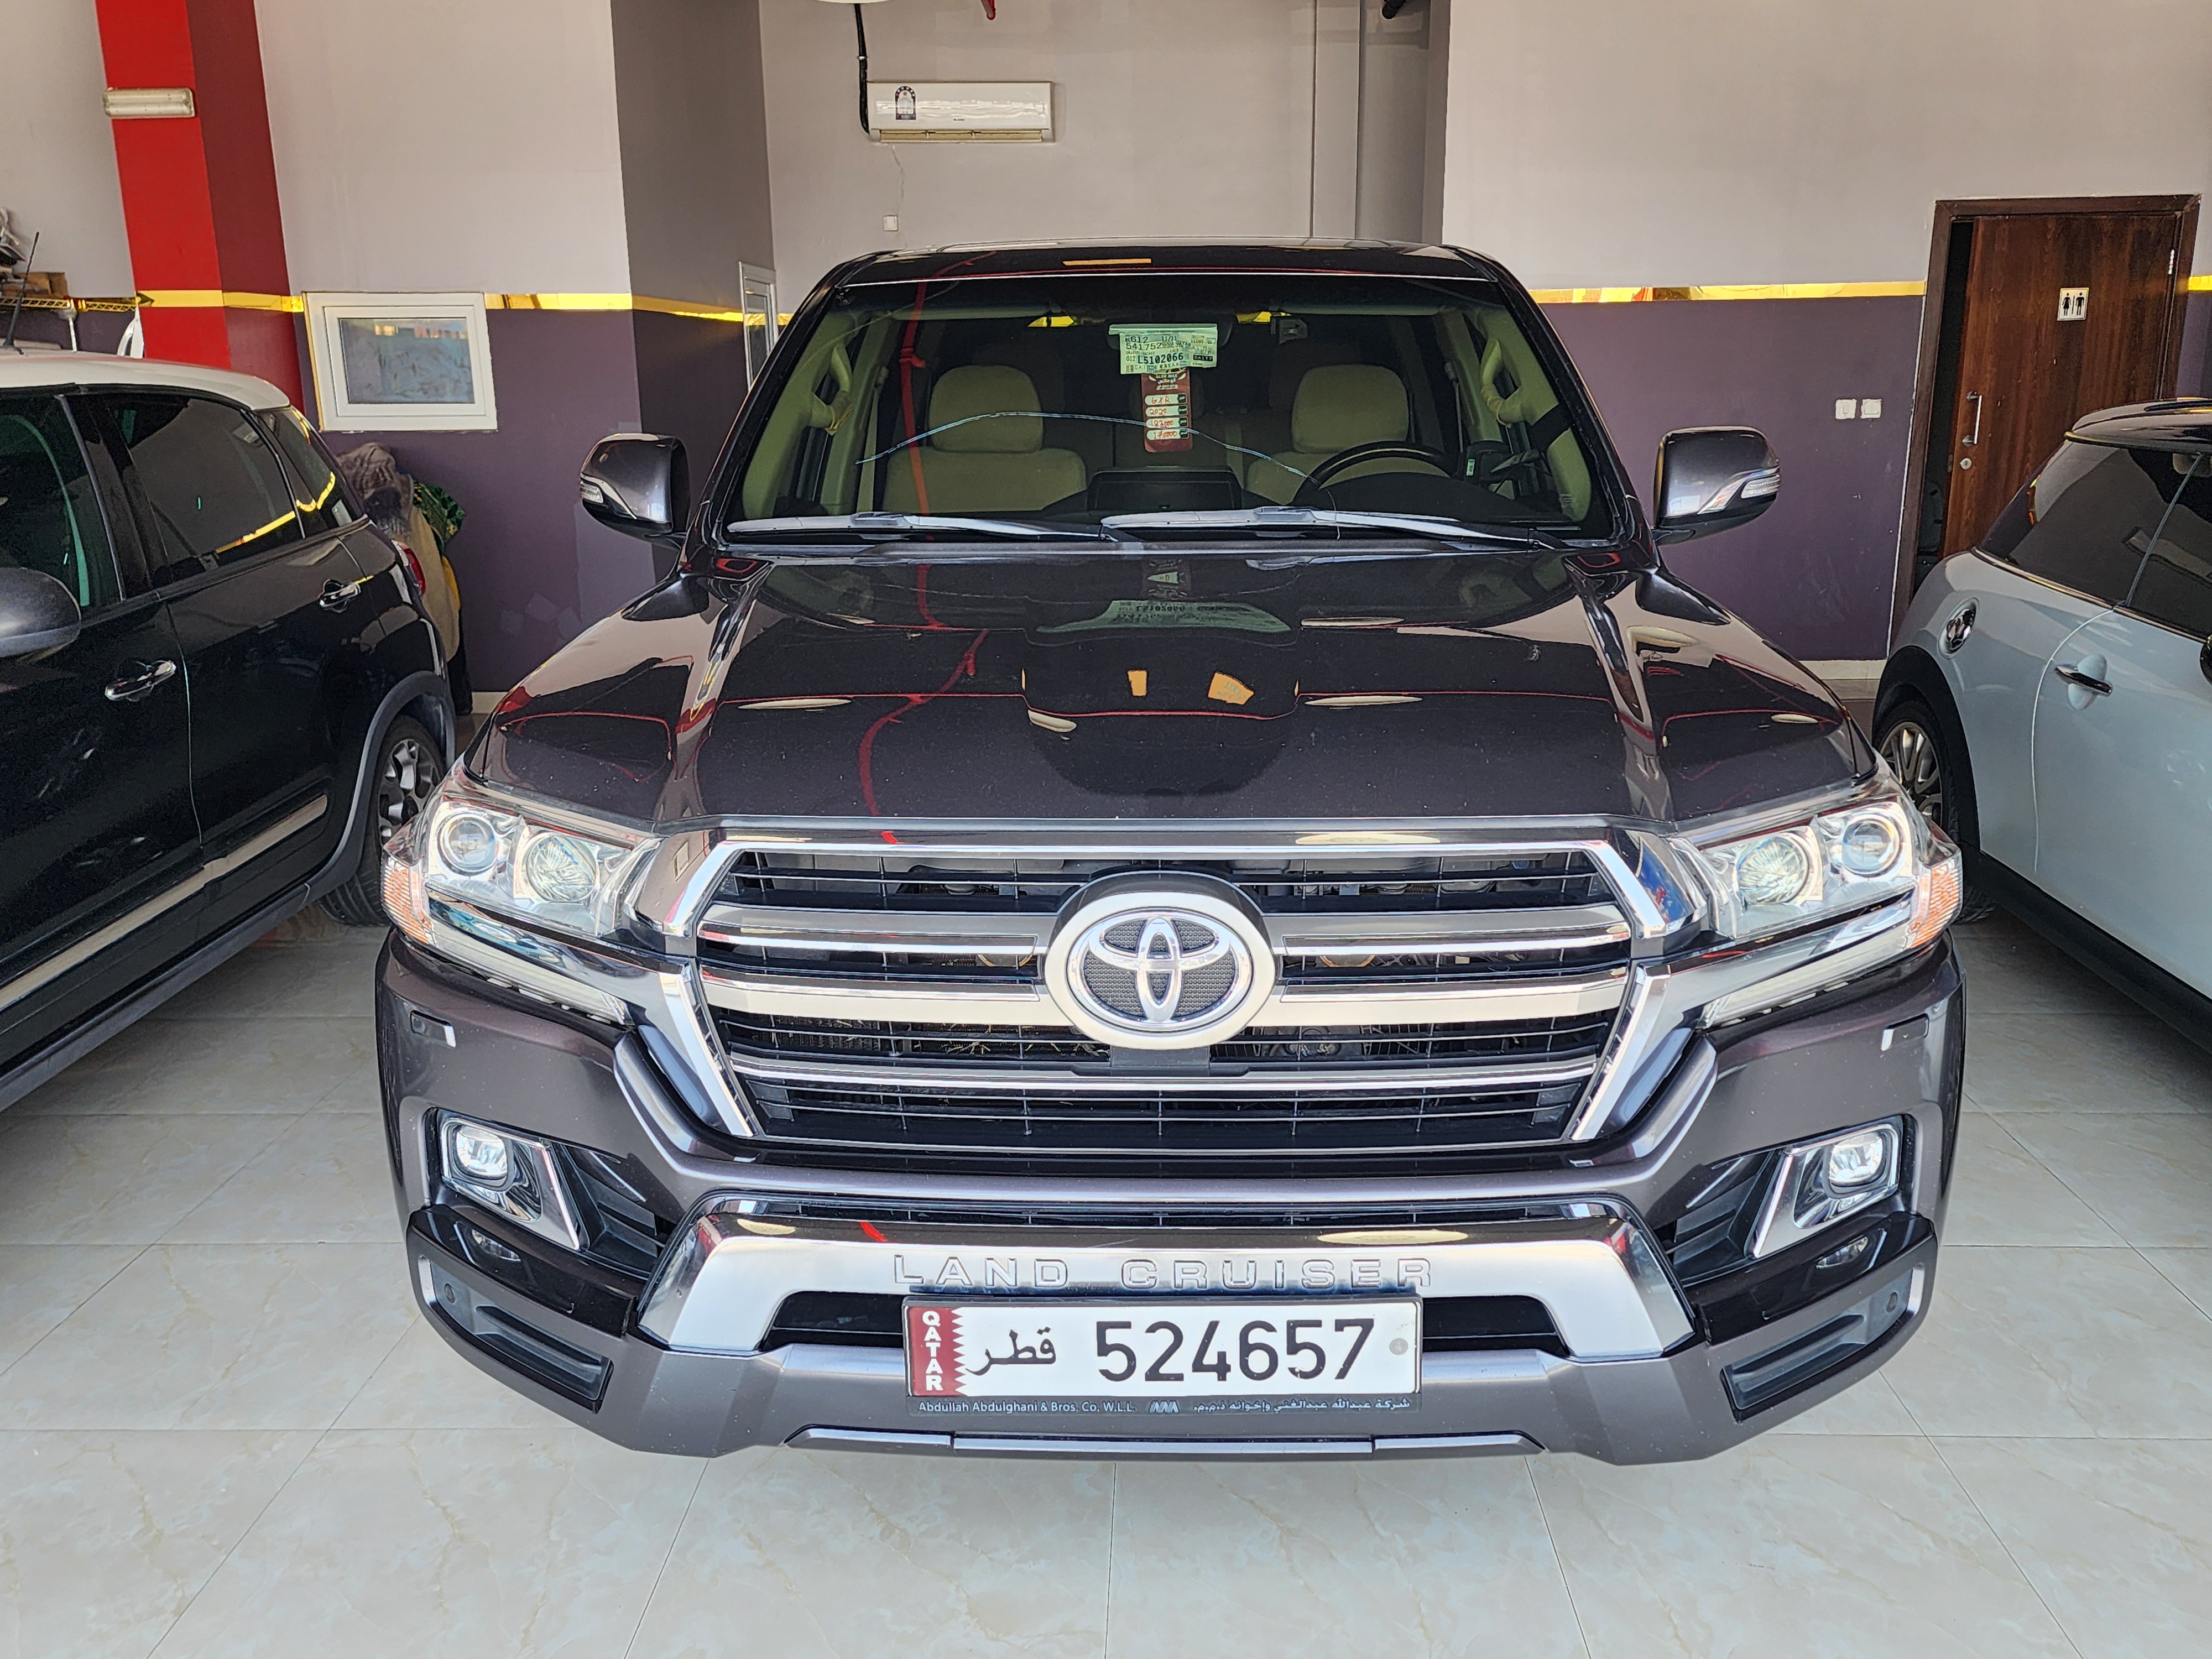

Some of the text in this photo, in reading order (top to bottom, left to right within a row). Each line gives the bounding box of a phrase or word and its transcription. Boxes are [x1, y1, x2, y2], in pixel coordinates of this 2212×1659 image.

[1138, 353, 1183, 364] L5102066
[894, 1255, 1432, 1288] LAND CRUISER
[921, 1310, 945, 1392] QATAR
[966, 1327, 1057, 1376] قطر
[1095, 1317, 1375, 1381] 524657
[919, 1400, 1136, 1415] Abdullah Abdulghani & Bros. Co. W.L.L.
[1331, 1396, 1371, 1411] عبدالله
[1375, 1397, 1411, 1410] شركة
